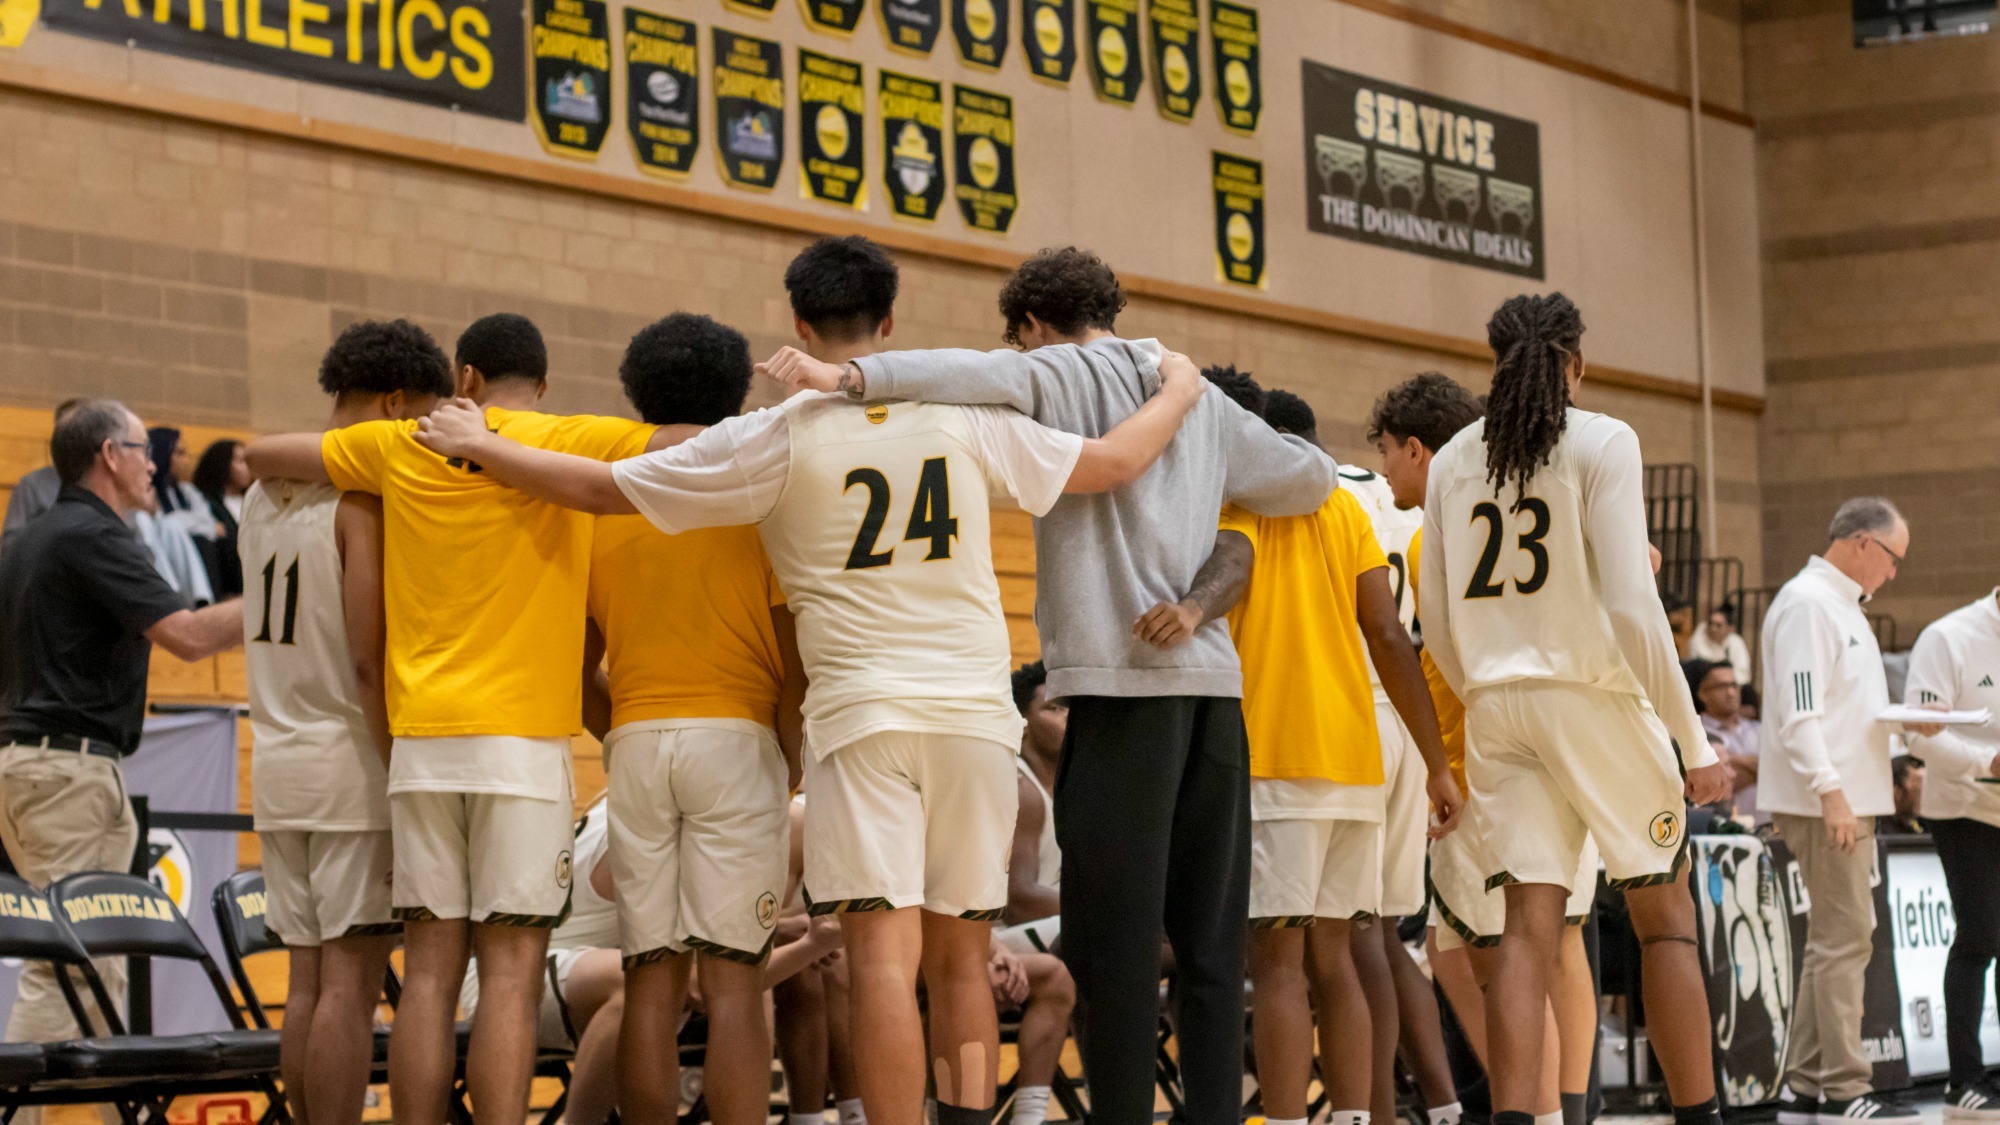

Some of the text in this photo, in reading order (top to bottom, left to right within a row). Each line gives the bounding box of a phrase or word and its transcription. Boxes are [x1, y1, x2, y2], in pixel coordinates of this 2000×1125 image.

[84, 0, 494, 90] LETICS
[534, 24, 609, 72] CHAMPIONS
[625, 30, 696, 78] CHAMPION
[1355, 87, 1496, 171] SERVICE
[1318, 194, 1534, 269] THE DOMINICAN IDEALS
[842, 455, 960, 571] 24
[1463, 497, 1552, 601] 23
[253, 551, 299, 646] 11
[62, 892, 175, 924] DOMINICAN
[1896, 886, 1957, 948] letic
